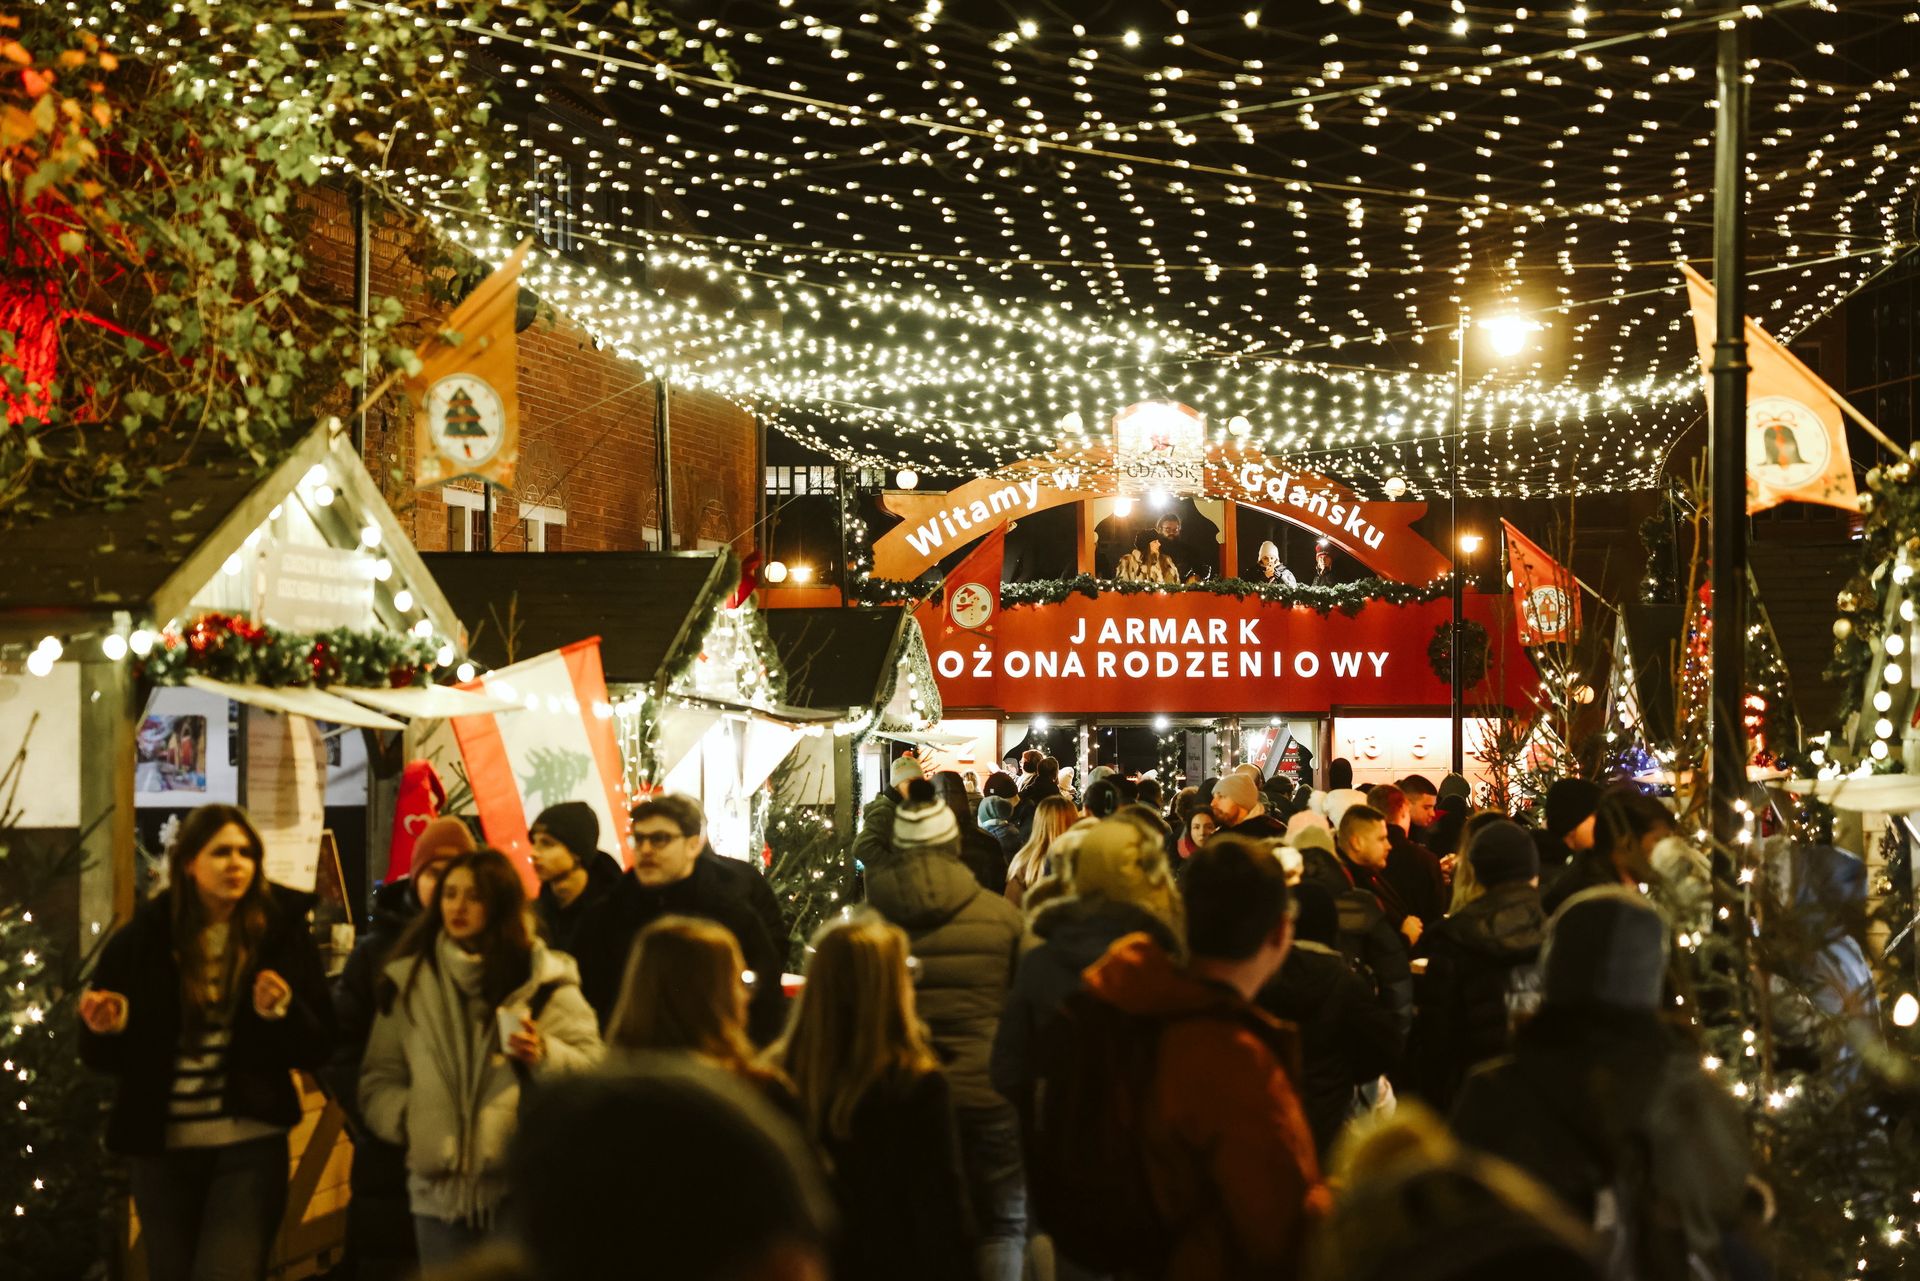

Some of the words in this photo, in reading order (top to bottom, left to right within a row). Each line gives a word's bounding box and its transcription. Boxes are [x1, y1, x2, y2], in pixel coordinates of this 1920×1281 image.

[905, 477, 1039, 557] Witamy
[1052, 468, 1080, 491] w
[1240, 463, 1385, 550] Gdańsku
[1070, 618, 1261, 644] JARMARK
[937, 643, 1389, 678] OŻONARODZENIOWY
